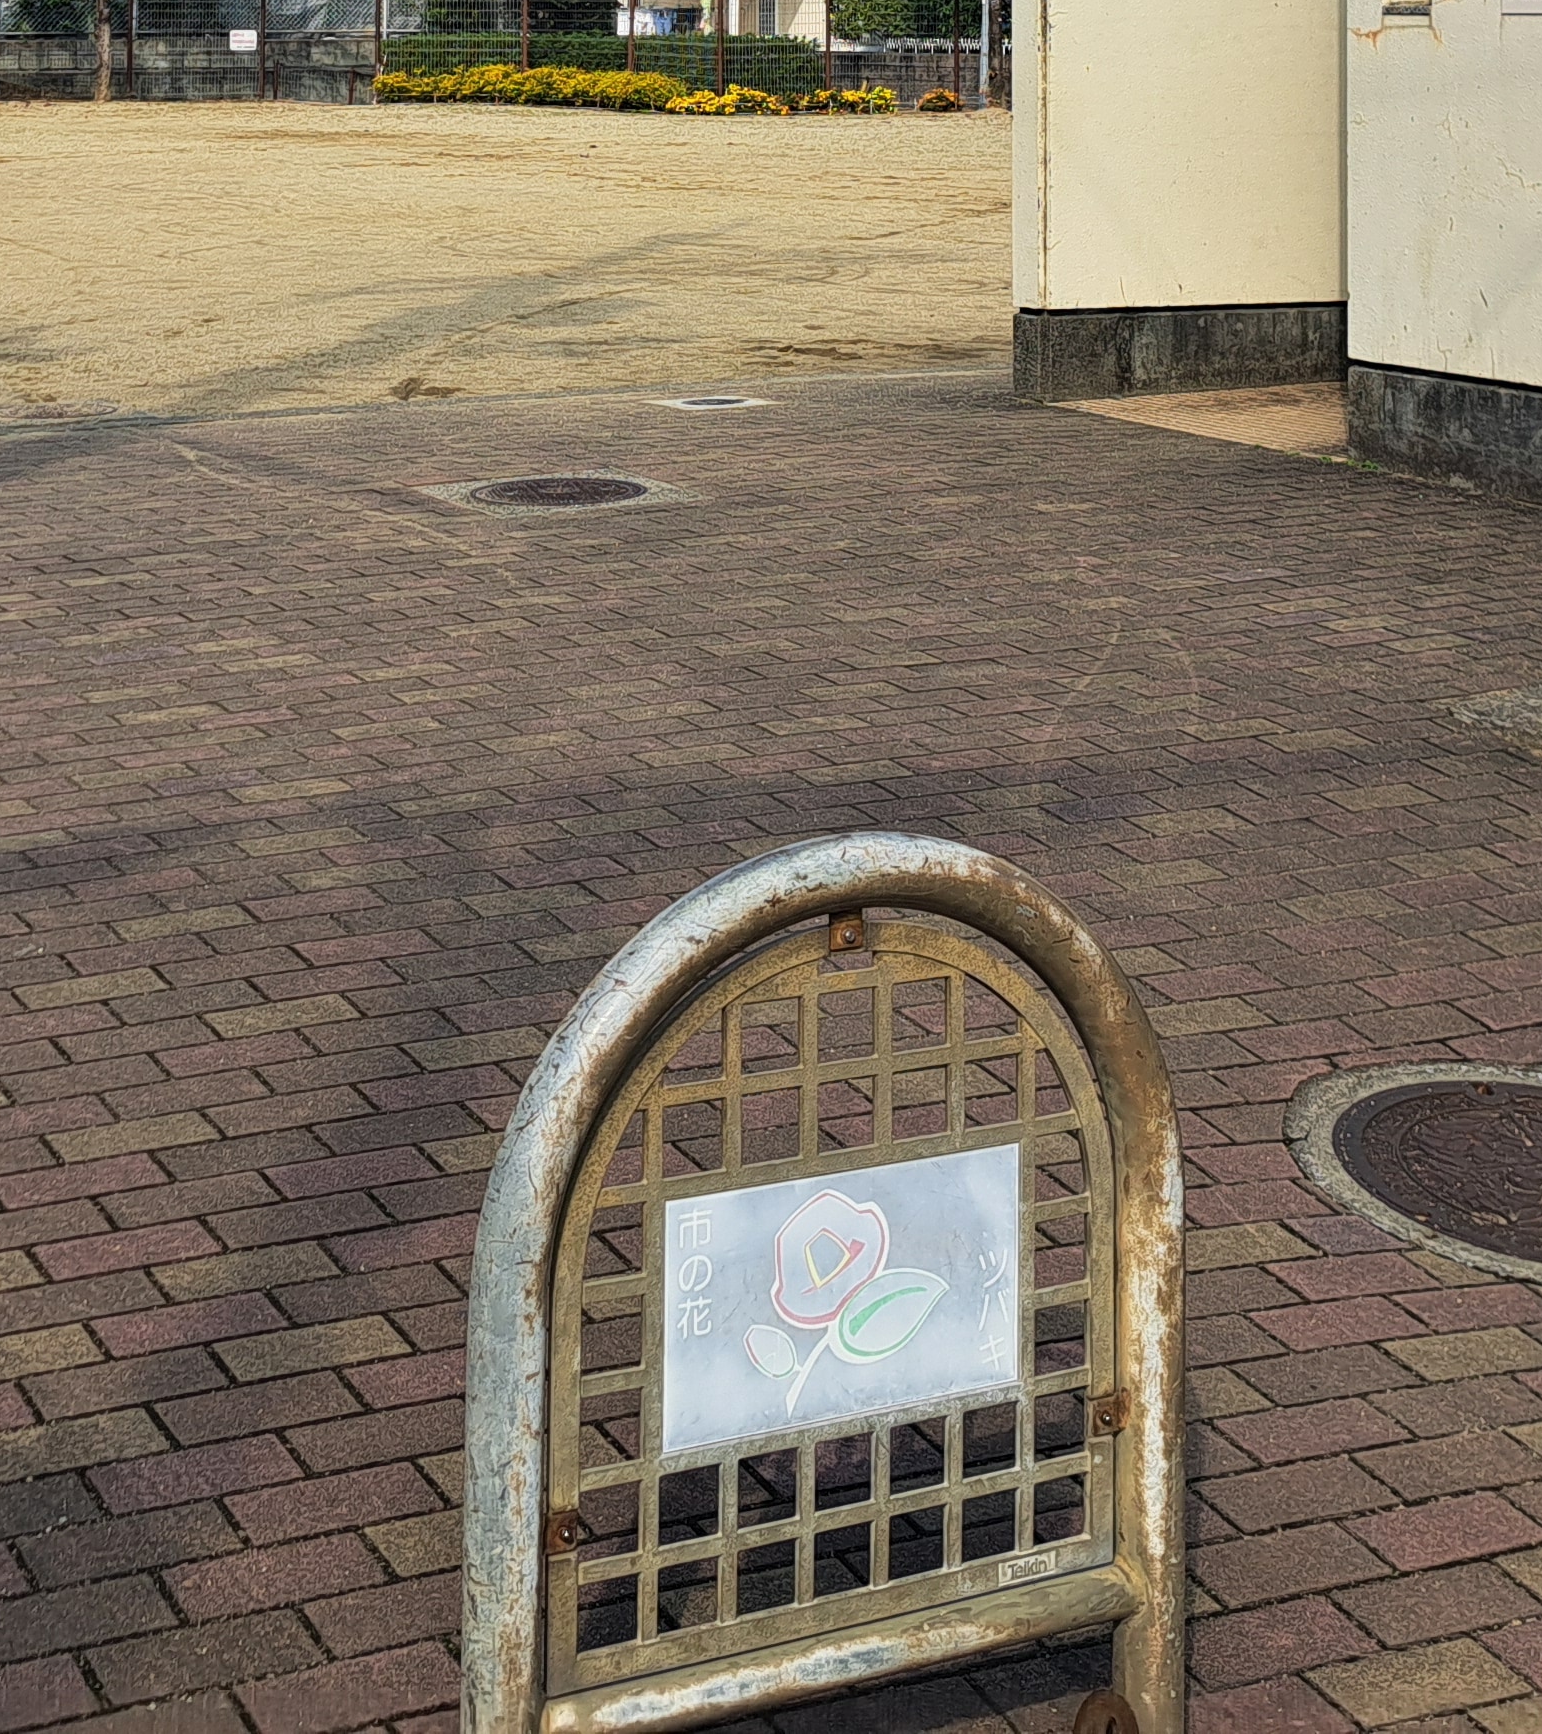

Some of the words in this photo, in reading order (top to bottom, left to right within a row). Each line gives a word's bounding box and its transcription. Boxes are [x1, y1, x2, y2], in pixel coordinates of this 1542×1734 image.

[676, 1207, 714, 1341] 市の花
[977, 1248, 1011, 1371] ツバキ
